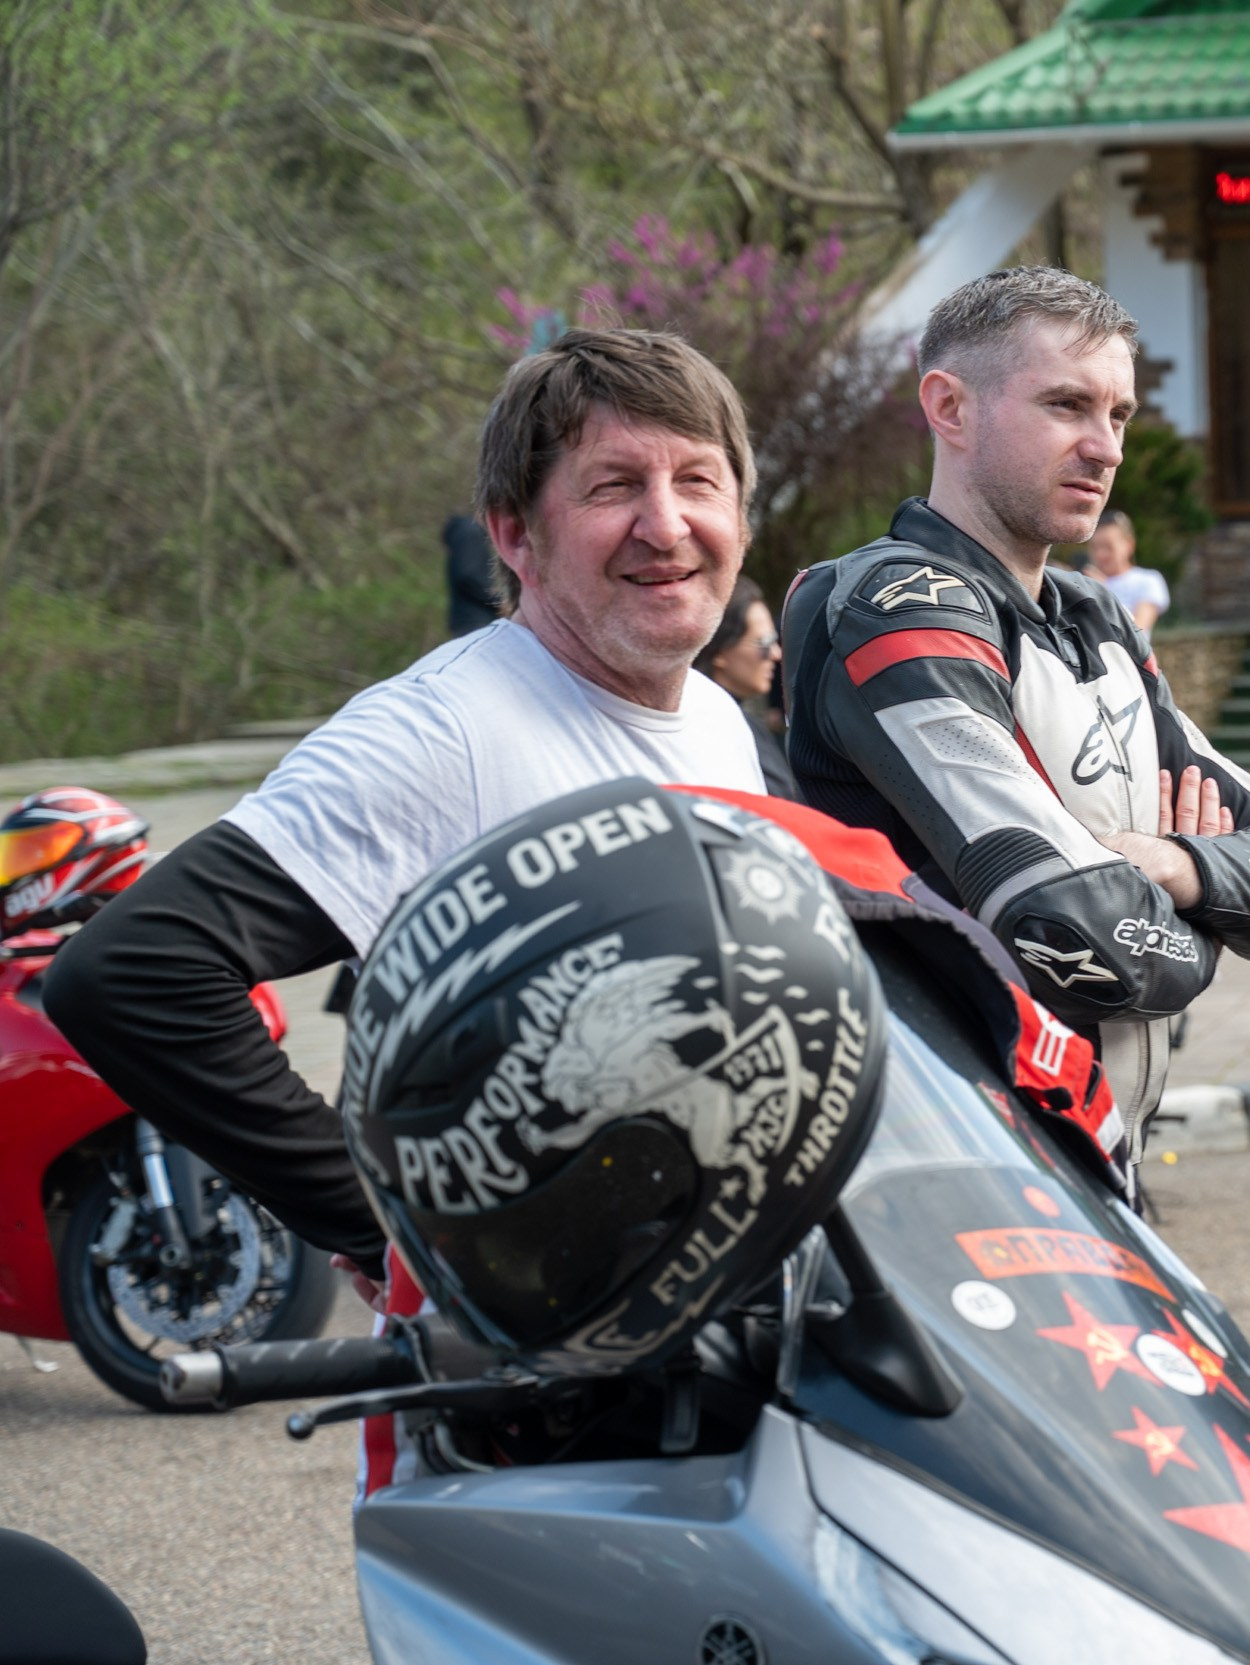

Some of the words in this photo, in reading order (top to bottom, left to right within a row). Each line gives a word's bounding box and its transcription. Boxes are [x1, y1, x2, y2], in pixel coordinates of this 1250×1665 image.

[374, 863, 508, 1004] WIDE
[506, 797, 674, 889] OPEN
[395, 934, 624, 1215] PERFORMANCE
[652, 1201, 758, 1306] FULL
[783, 987, 868, 1186] THROTTLE
[723, 1034, 784, 1086] 1971
